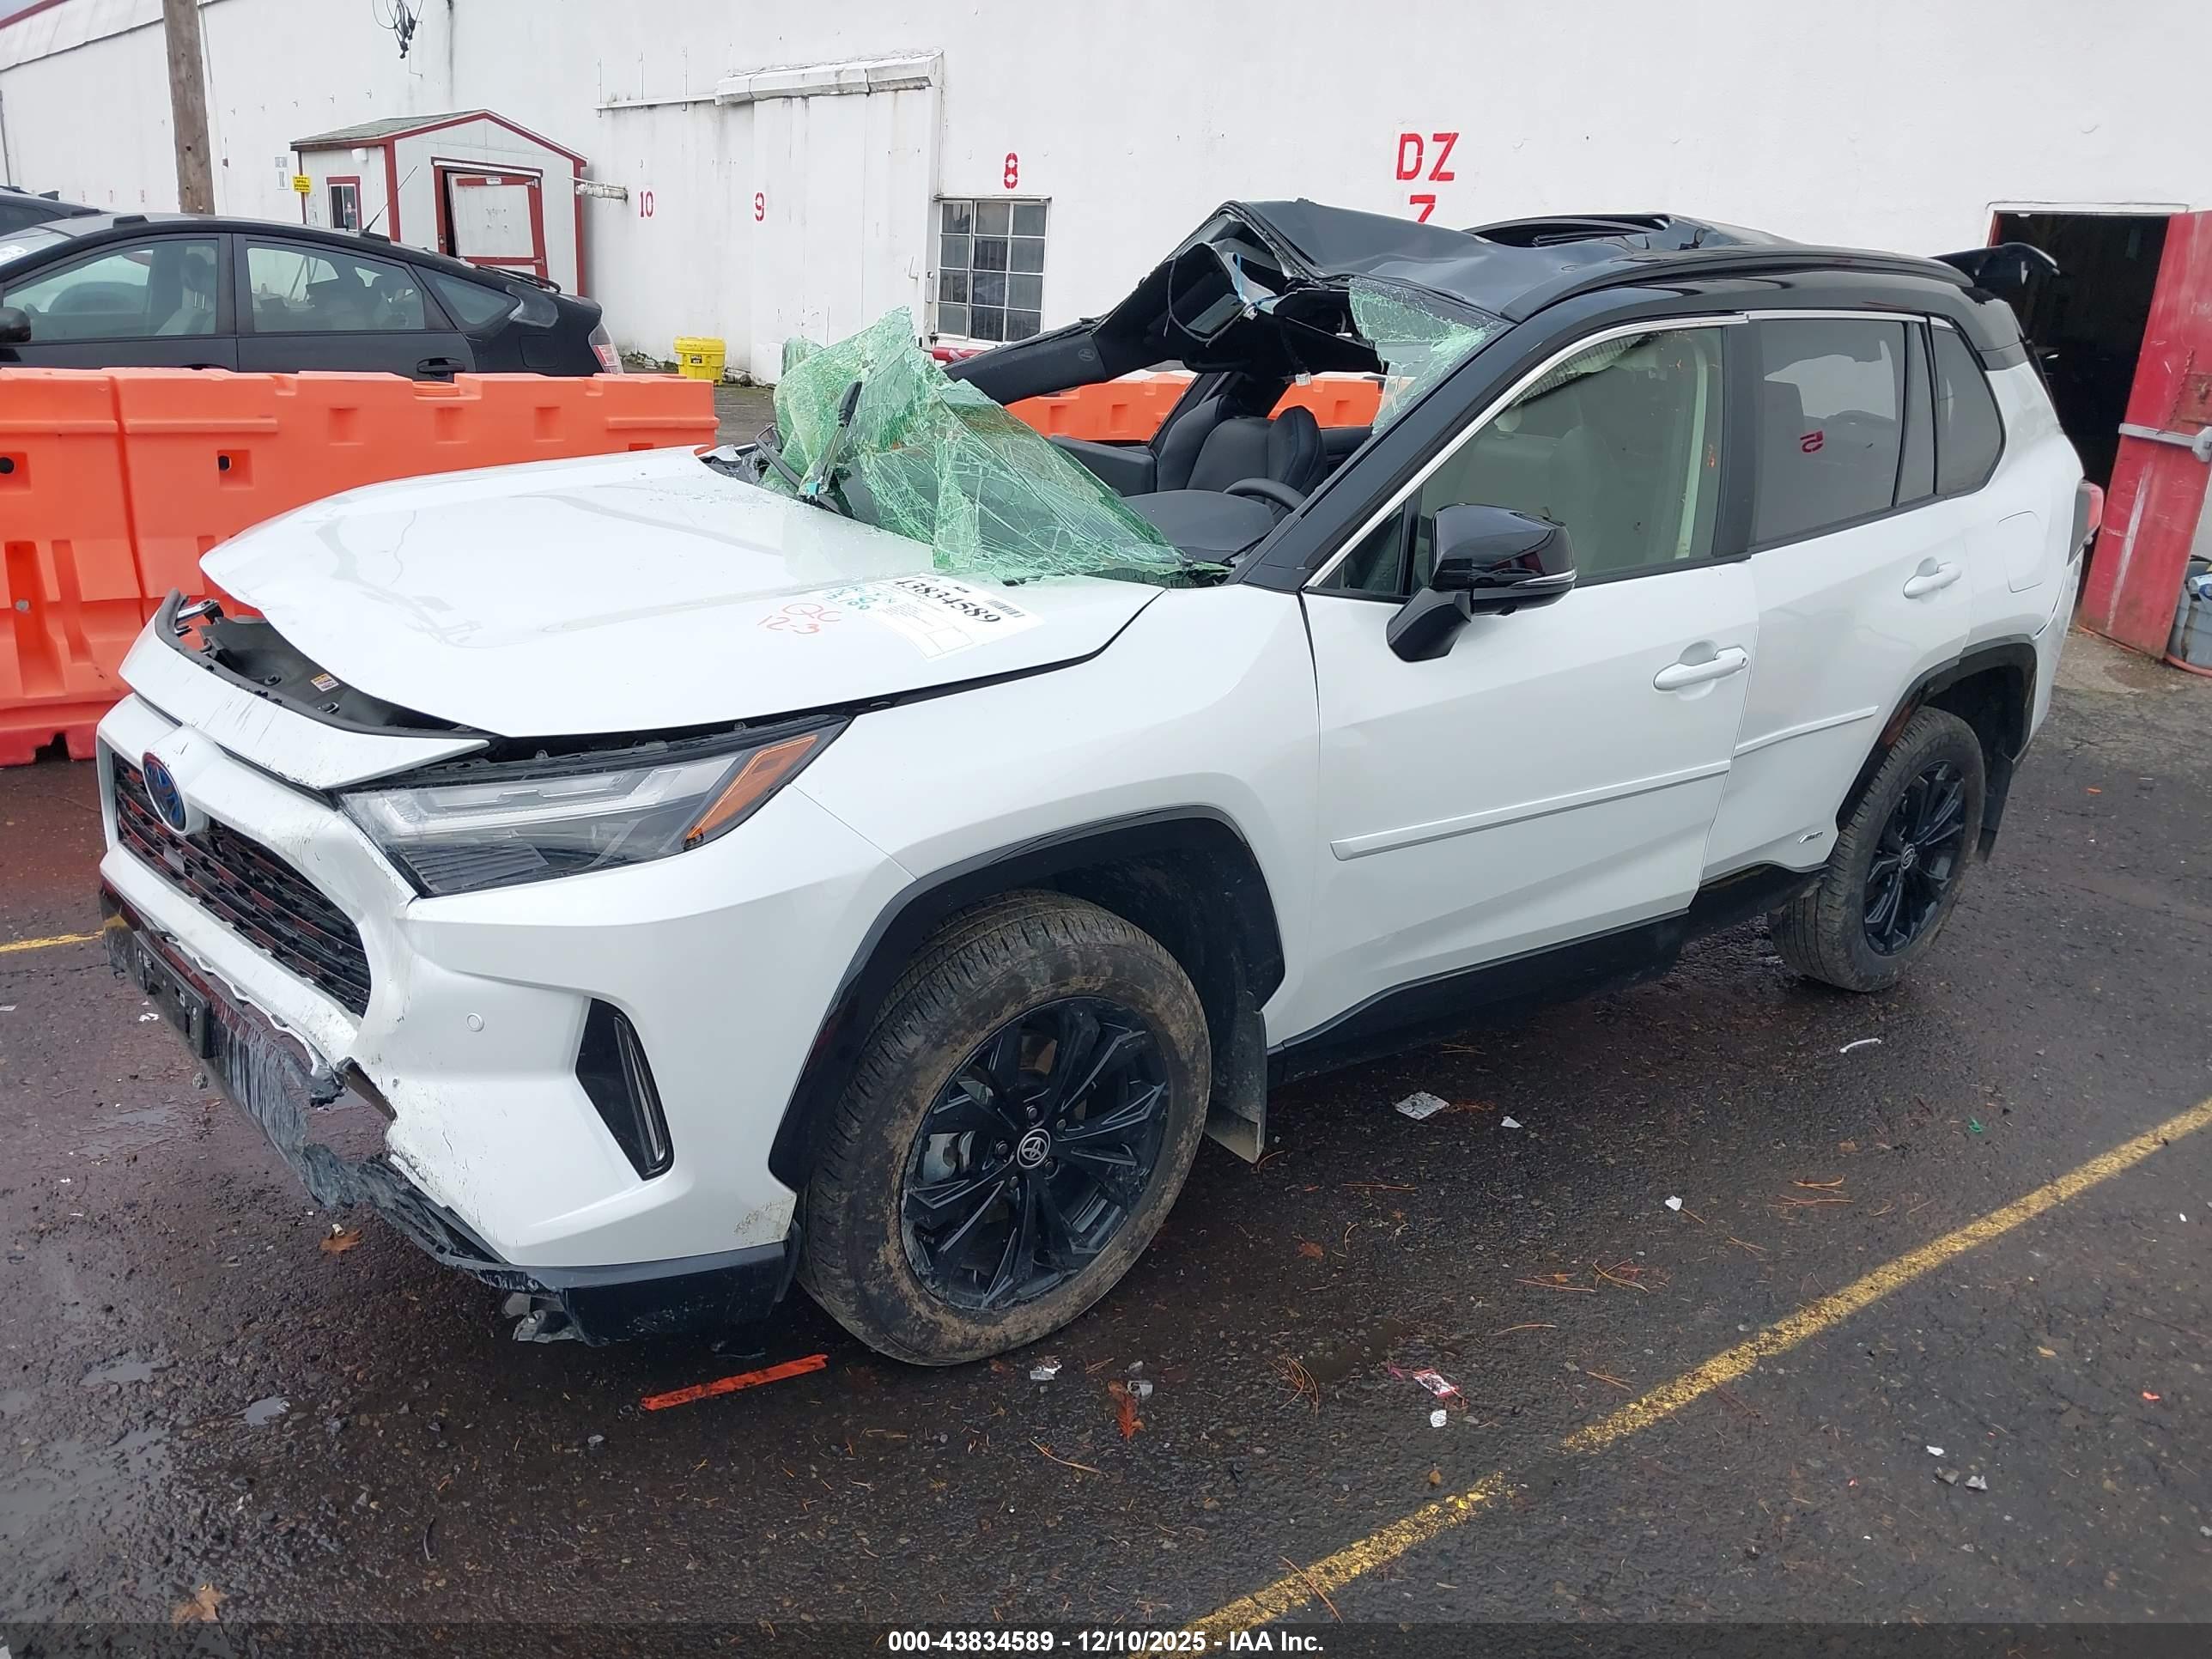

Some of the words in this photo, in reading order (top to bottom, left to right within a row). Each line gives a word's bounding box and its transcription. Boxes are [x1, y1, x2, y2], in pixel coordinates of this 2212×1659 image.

[1003, 152, 1018, 190] 8
[1396, 132, 1459, 181] DZ
[640, 191, 654, 218] 10
[755, 191, 765, 222] 9
[1409, 194, 1436, 223] 7
[782, 603, 843, 622] QC
[894, 580, 1002, 623] 43834589
